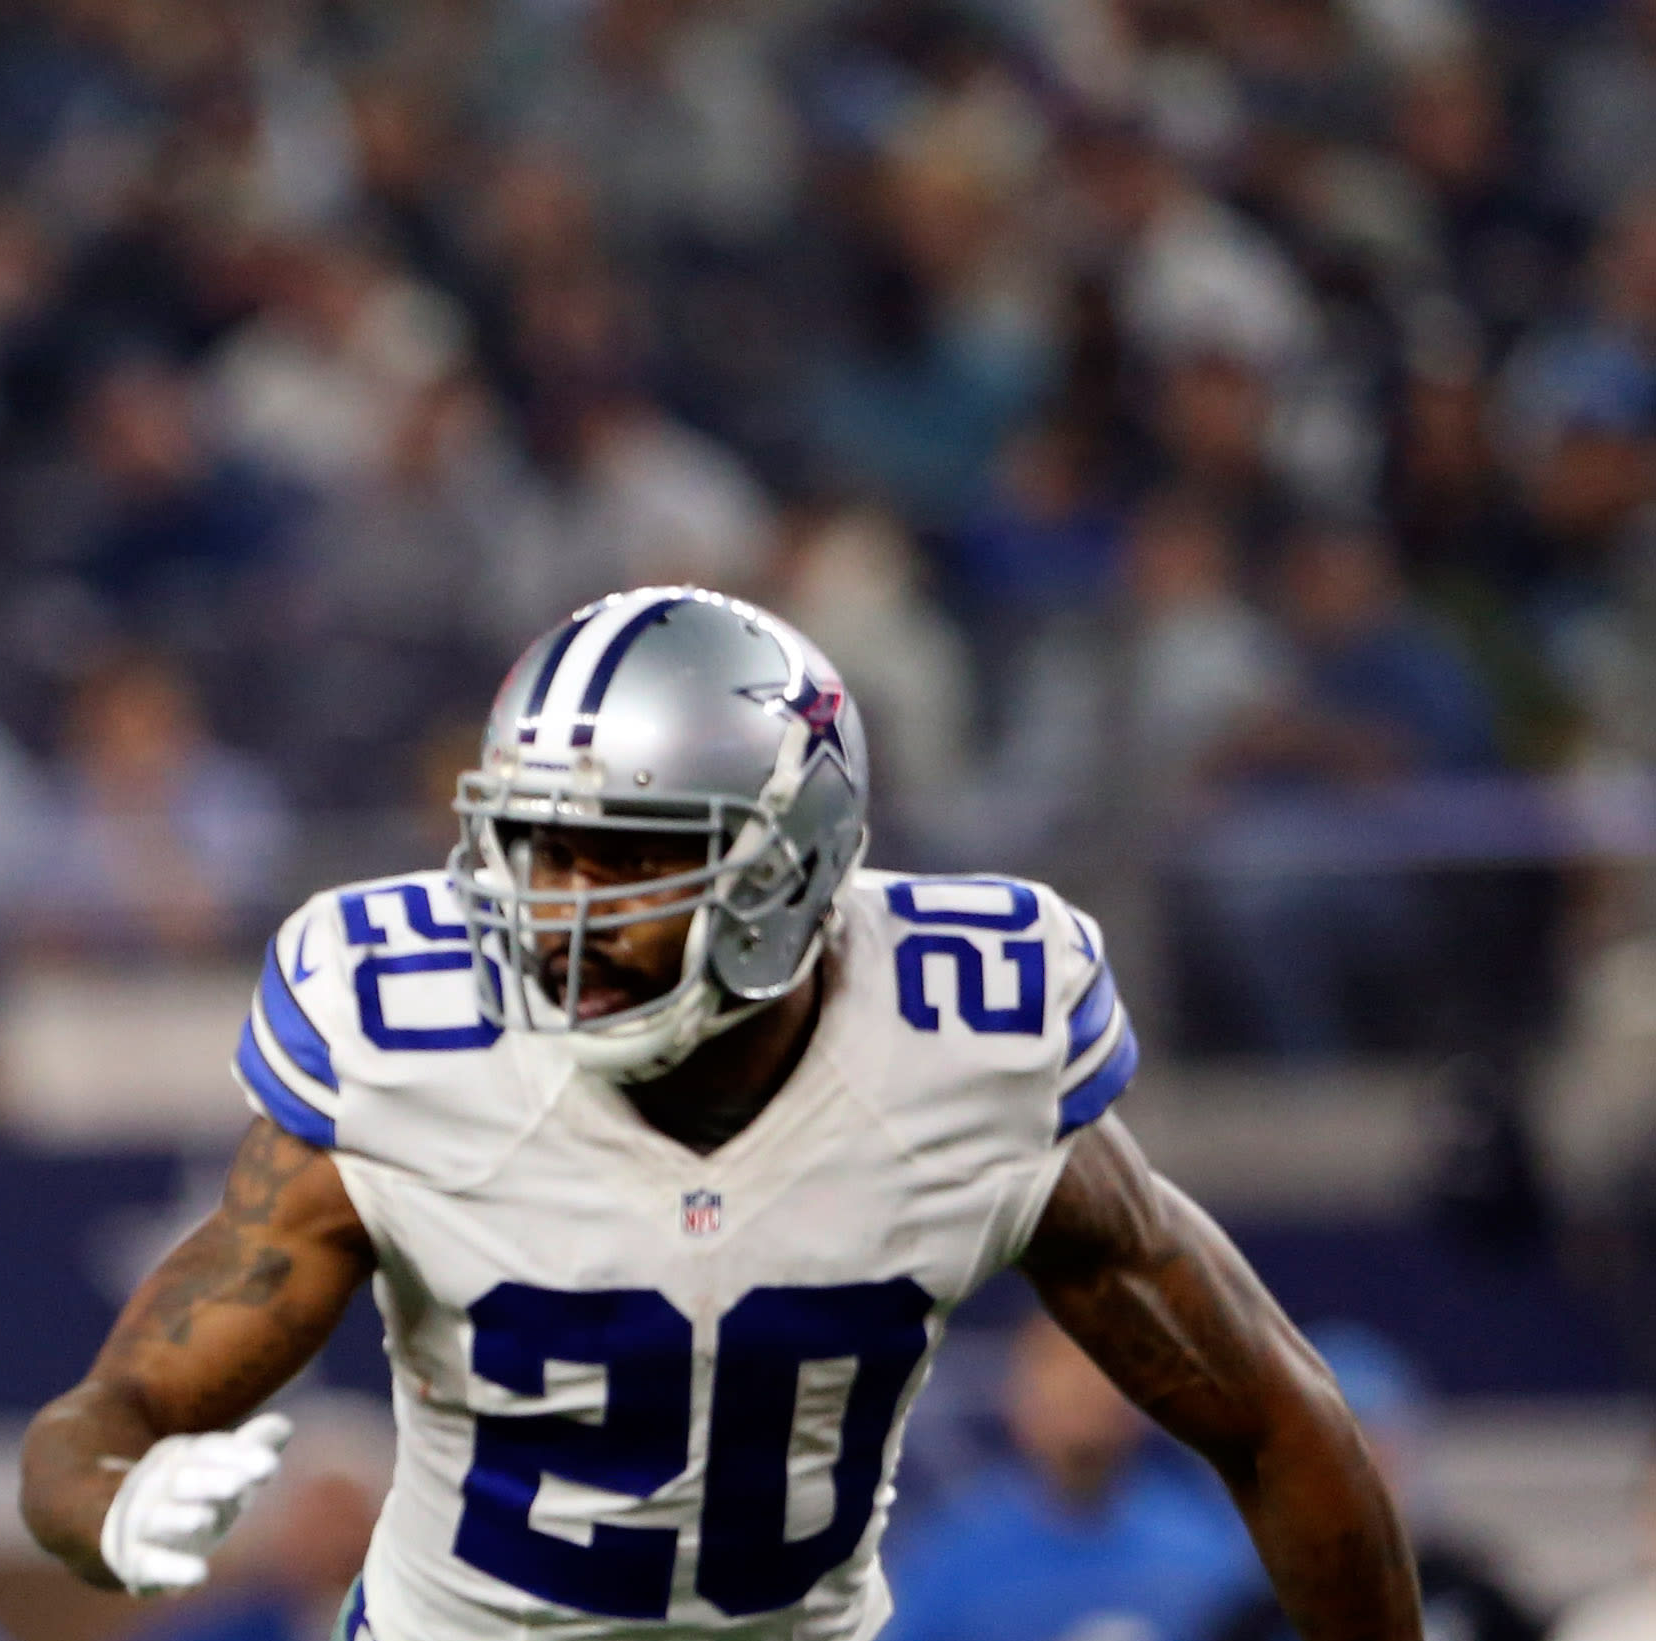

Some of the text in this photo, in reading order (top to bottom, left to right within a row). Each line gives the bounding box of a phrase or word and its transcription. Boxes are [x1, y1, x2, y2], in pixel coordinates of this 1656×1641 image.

[338, 884, 506, 1052] 20
[884, 879, 1046, 1037] 20
[453, 1275, 936, 1621] 20
